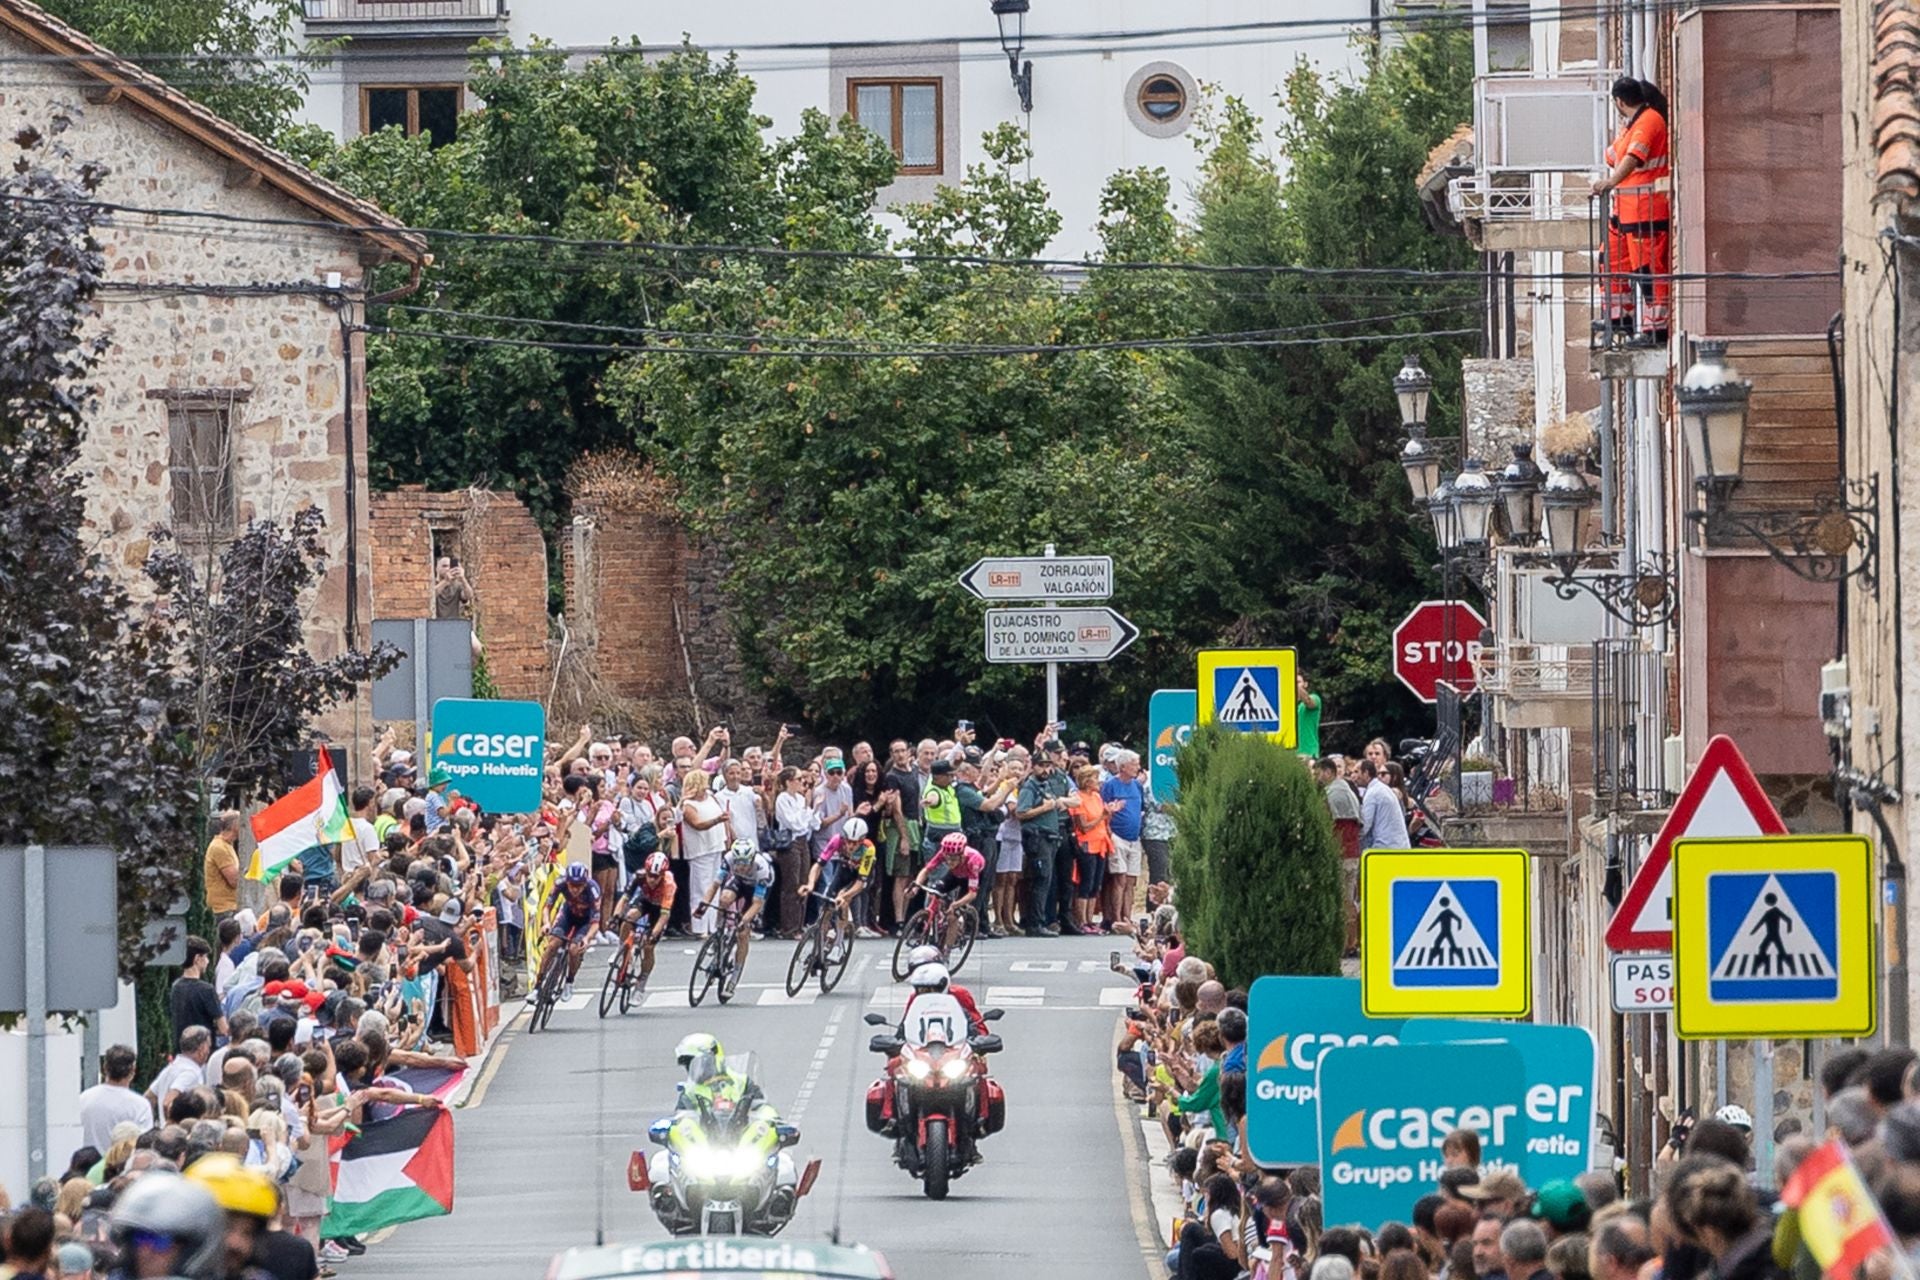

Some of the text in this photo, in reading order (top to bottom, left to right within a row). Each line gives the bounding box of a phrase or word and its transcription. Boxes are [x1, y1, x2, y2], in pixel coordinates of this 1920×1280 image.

[1040, 564, 1105, 577] ZORRAQUÍN
[990, 574, 1019, 584] LR-111
[1044, 580, 1105, 593] VALGAÑÓN
[993, 615, 1061, 627] OJACASTRO
[993, 631, 1076, 644] STO. DOMINGO
[1080, 629, 1109, 639] LR-111
[999, 645, 1070, 656] DE LA CALZADA
[457, 733, 539, 758] caser
[482, 762, 538, 777] Helvetia
[1627, 964, 1671, 980] PAS
[1256, 1079, 1320, 1105] Grup
[1368, 1105, 1517, 1150] caser
[1331, 1161, 1413, 1190] Grupo
[621, 1241, 816, 1271] Fertiberia
